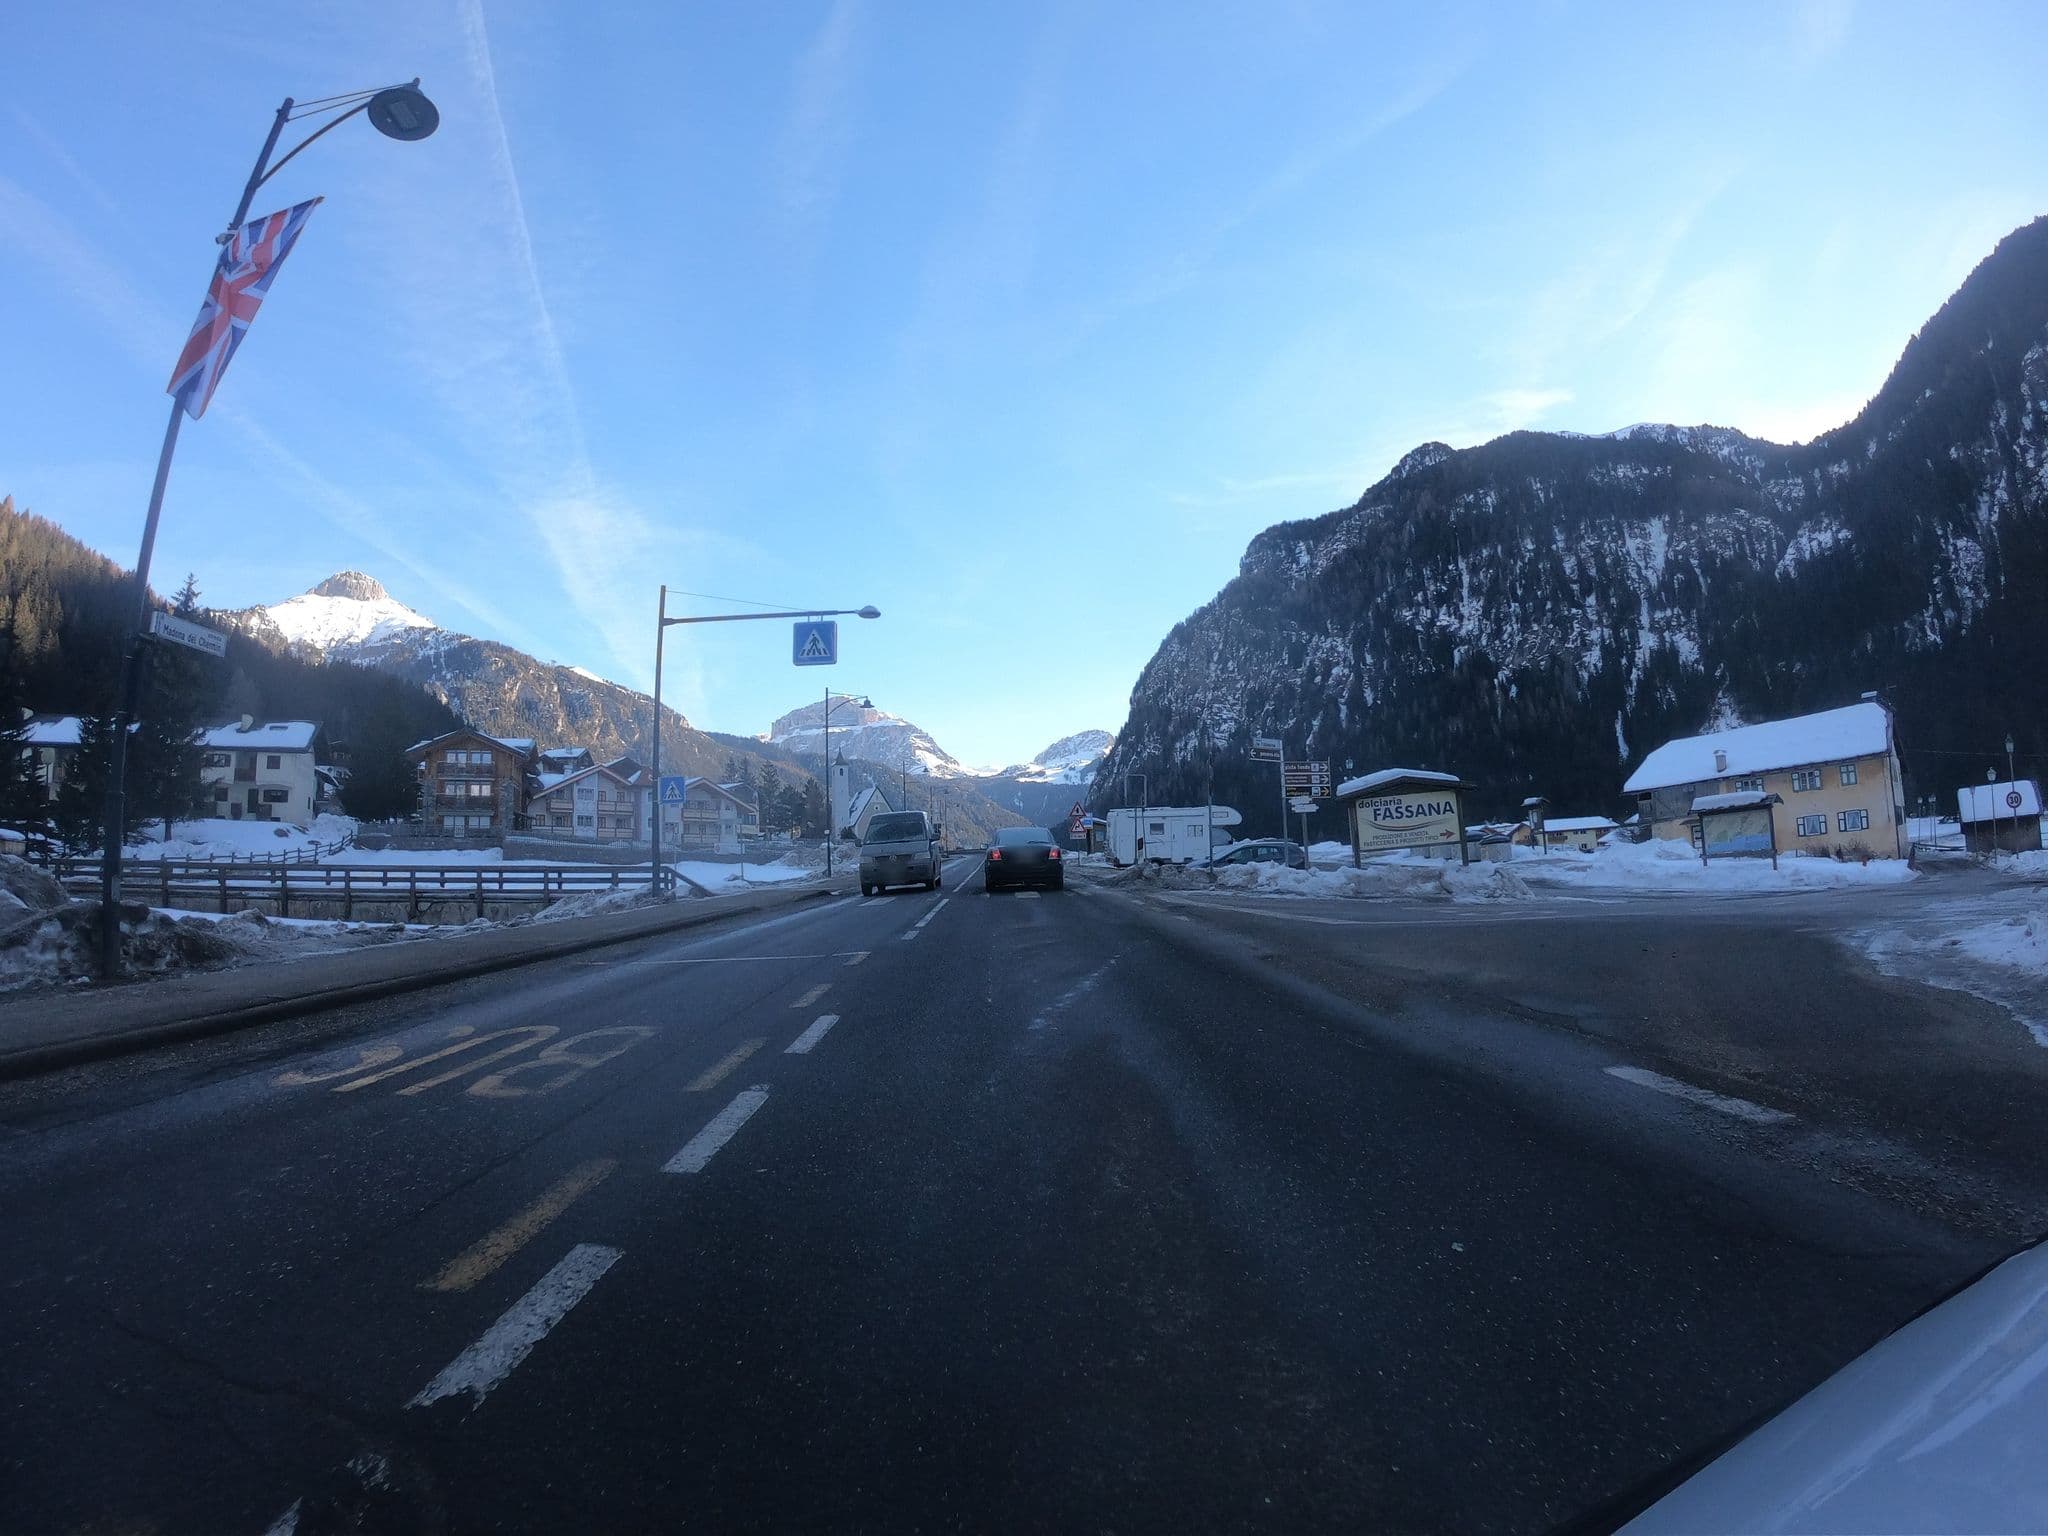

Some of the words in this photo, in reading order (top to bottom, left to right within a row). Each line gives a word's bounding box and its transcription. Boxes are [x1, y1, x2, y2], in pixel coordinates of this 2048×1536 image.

[1358, 797, 1402, 809] dolciaria
[2009, 795, 2019, 804] 30
[1373, 801, 1455, 822] FASSANA
[1372, 831, 1404, 841] PRODUZIONE
[1363, 839, 1395, 847] PASTICCERIA
